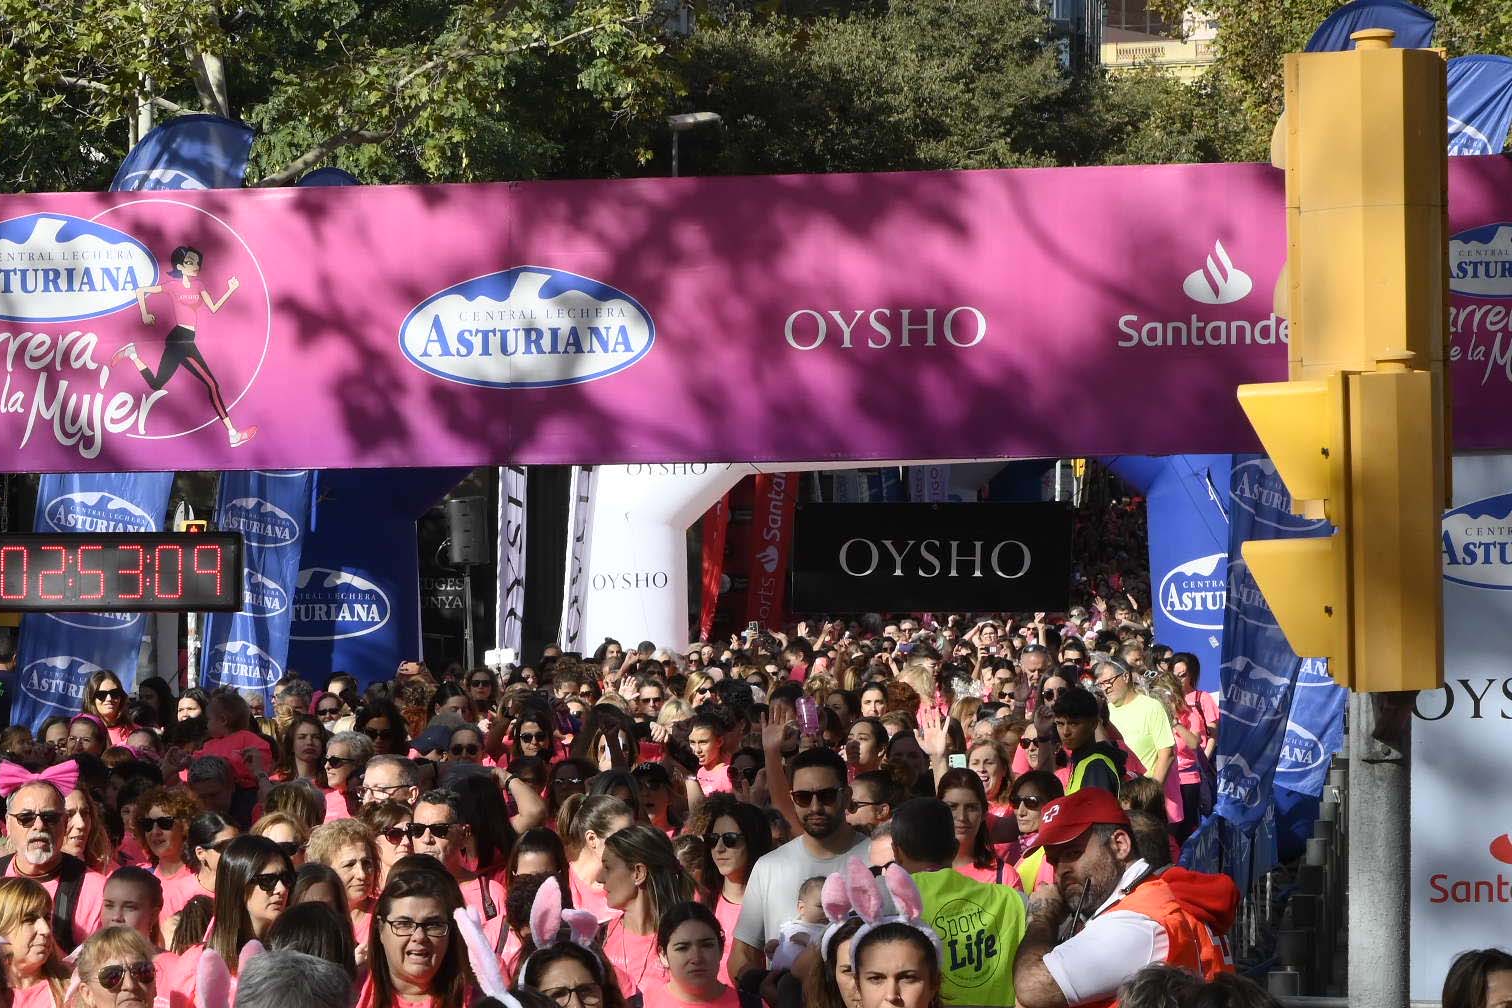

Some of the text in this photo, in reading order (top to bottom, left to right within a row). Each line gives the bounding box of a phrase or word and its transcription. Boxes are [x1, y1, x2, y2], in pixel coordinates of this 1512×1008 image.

[61, 249, 135, 262] LECHERA
[458, 305, 626, 321] CENTRAL LECHERA
[784, 305, 988, 351] OYSHO
[419, 313, 634, 359] ASTURIANA
[1467, 333, 1486, 361] la
[0, 373, 25, 413] la
[19, 366, 169, 459] Mujer
[69, 504, 107, 518] CENTRAL
[762, 472, 787, 542] Santa
[223, 509, 291, 541] ASTURIANA
[0, 544, 222, 600] 02:53:09
[838, 537, 1033, 579] OYSHO
[592, 570, 669, 592] OYSHO
[1182, 580, 1225, 589] CENTRA
[26, 669, 86, 699] ASTURI
[209, 661, 276, 683] ASTURIANA
[934, 907, 988, 941] Sport
[947, 928, 998, 972] Life
